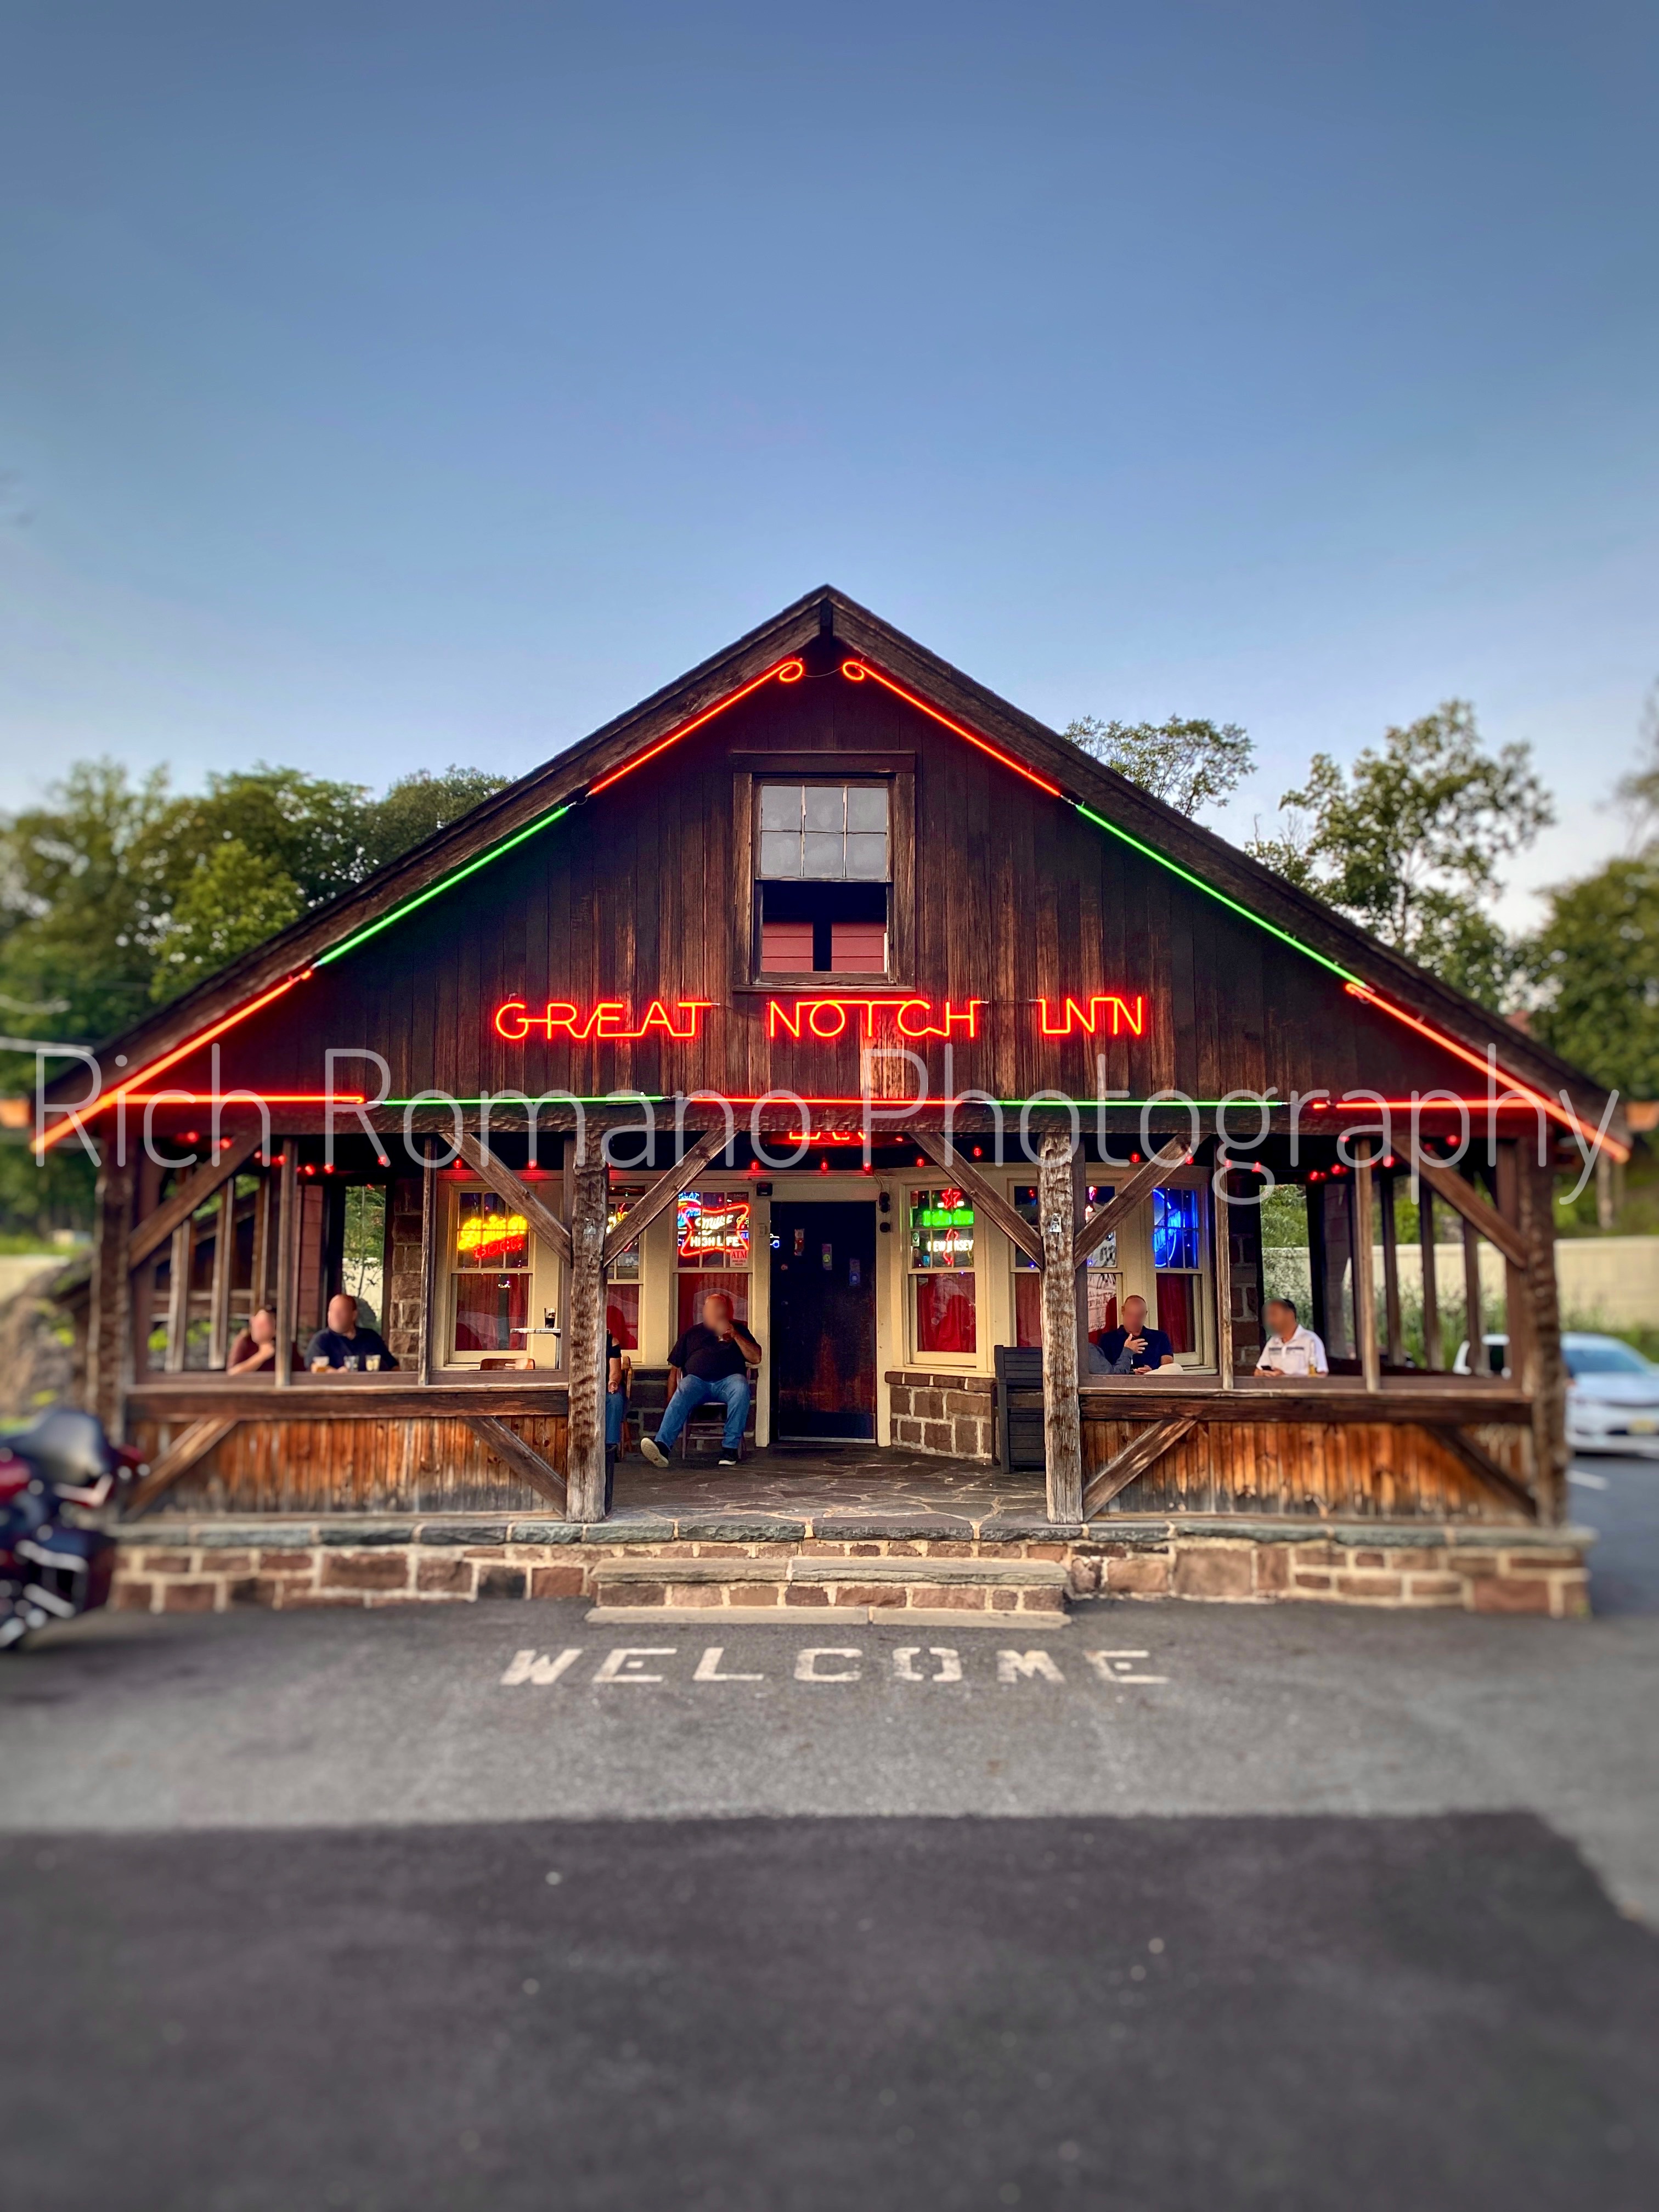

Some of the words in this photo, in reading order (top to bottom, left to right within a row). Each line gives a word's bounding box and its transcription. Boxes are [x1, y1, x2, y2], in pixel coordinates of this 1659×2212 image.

[495, 1001, 712, 1039] GREAT
[770, 999, 980, 1037] NOTCH
[1039, 996, 1142, 1035] INN
[716, 1235, 740, 1247] LFE
[731, 1250, 747, 1259] ATM
[500, 1647, 1170, 1686] WELCOME
